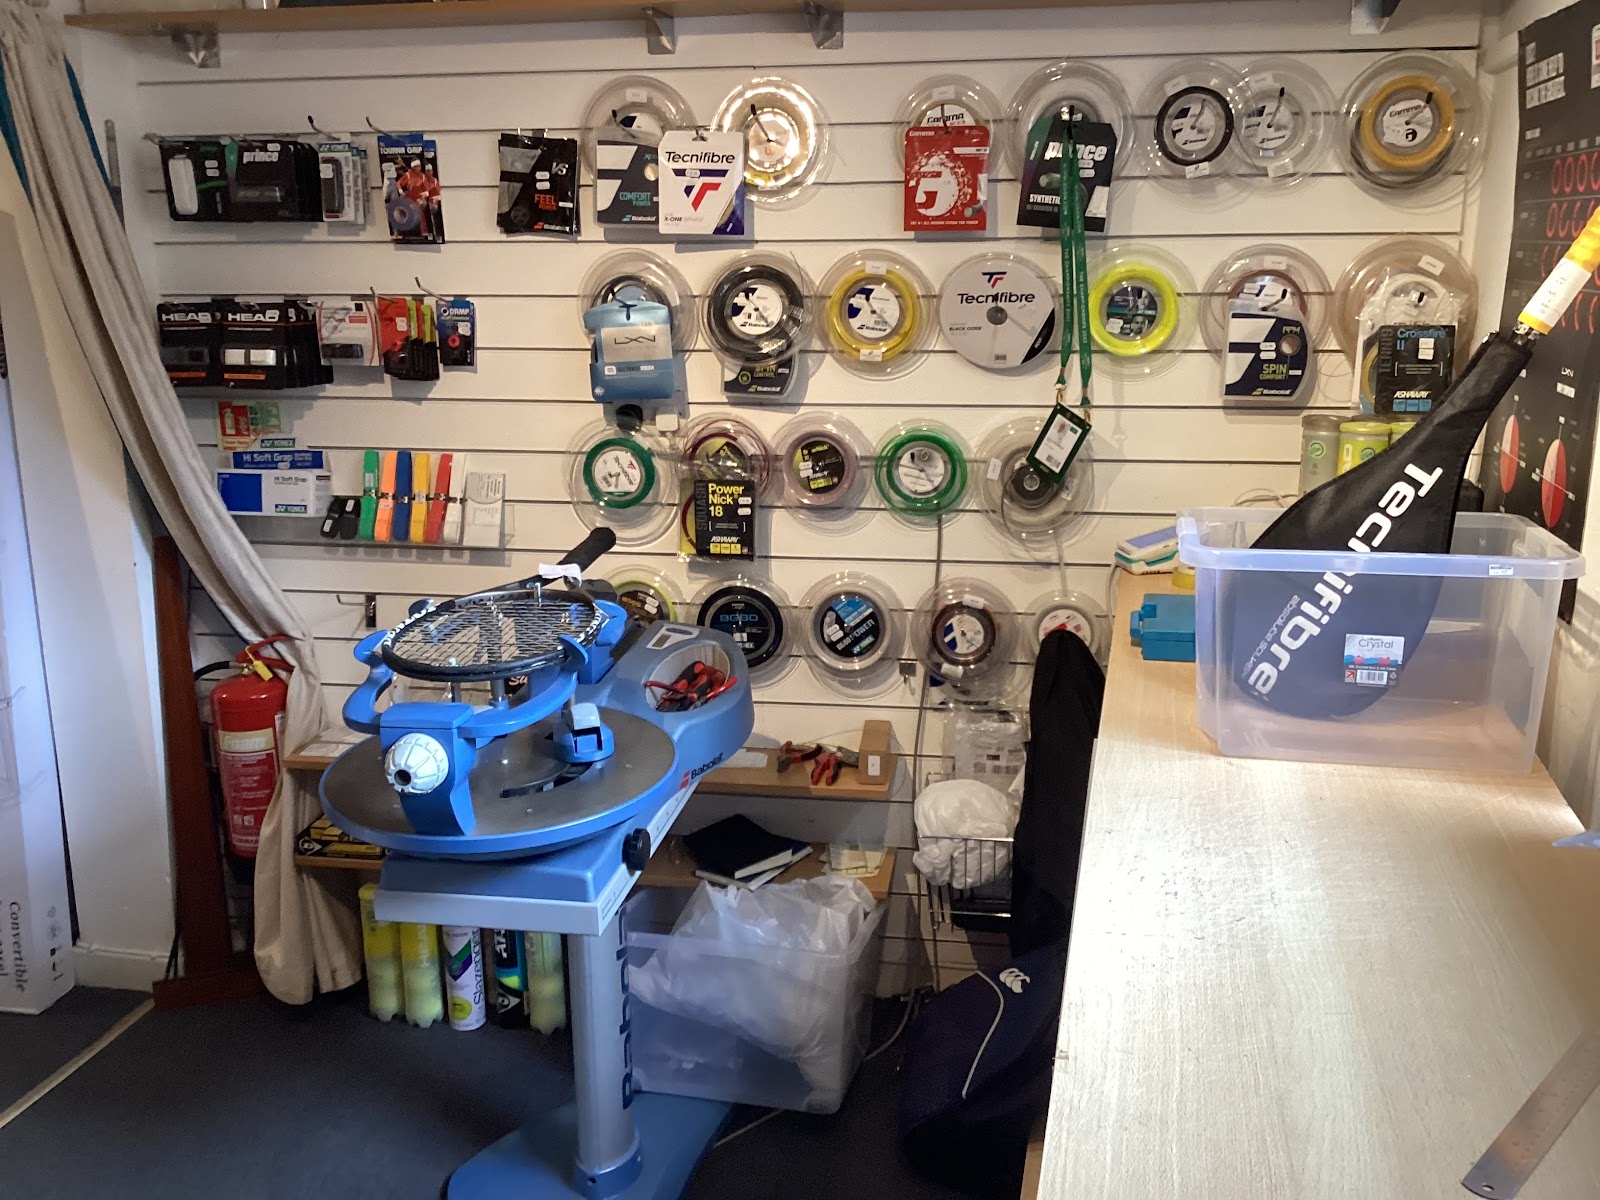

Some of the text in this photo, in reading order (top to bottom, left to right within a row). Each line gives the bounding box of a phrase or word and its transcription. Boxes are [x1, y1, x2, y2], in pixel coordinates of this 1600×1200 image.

[380, 146, 422, 155] TOURNA GRIP
[665, 151, 735, 164] Tecnifibre
[551, 161, 569, 175] VS
[534, 193, 557, 204] FEEL
[619, 191, 651, 201] COMFORT
[161, 312, 205, 322] HEA
[449, 307, 470, 316] DAMP
[1282, 325, 1300, 334] RPM
[1397, 327, 1446, 339] Crossfire
[614, 334, 656, 345] LXN
[1380, 328, 1393, 373] TENNIS
[1262, 363, 1287, 374] SPIN
[1393, 390, 1429, 399] ASHAWAY
[242, 454, 251, 462] Hi
[253, 453, 272, 462] Soft
[273, 453, 293, 463] Grap
[708, 483, 744, 495] Power
[708, 494, 734, 505] Nick
[695, 482, 707, 531] SQUASH
[708, 505, 723, 517] 18
[1358, 639, 1394, 649] Crystal
[690, 752, 724, 780] Babolat
[9, 901, 28, 992] Convertible
[471, 929, 484, 1006] Slazenger
